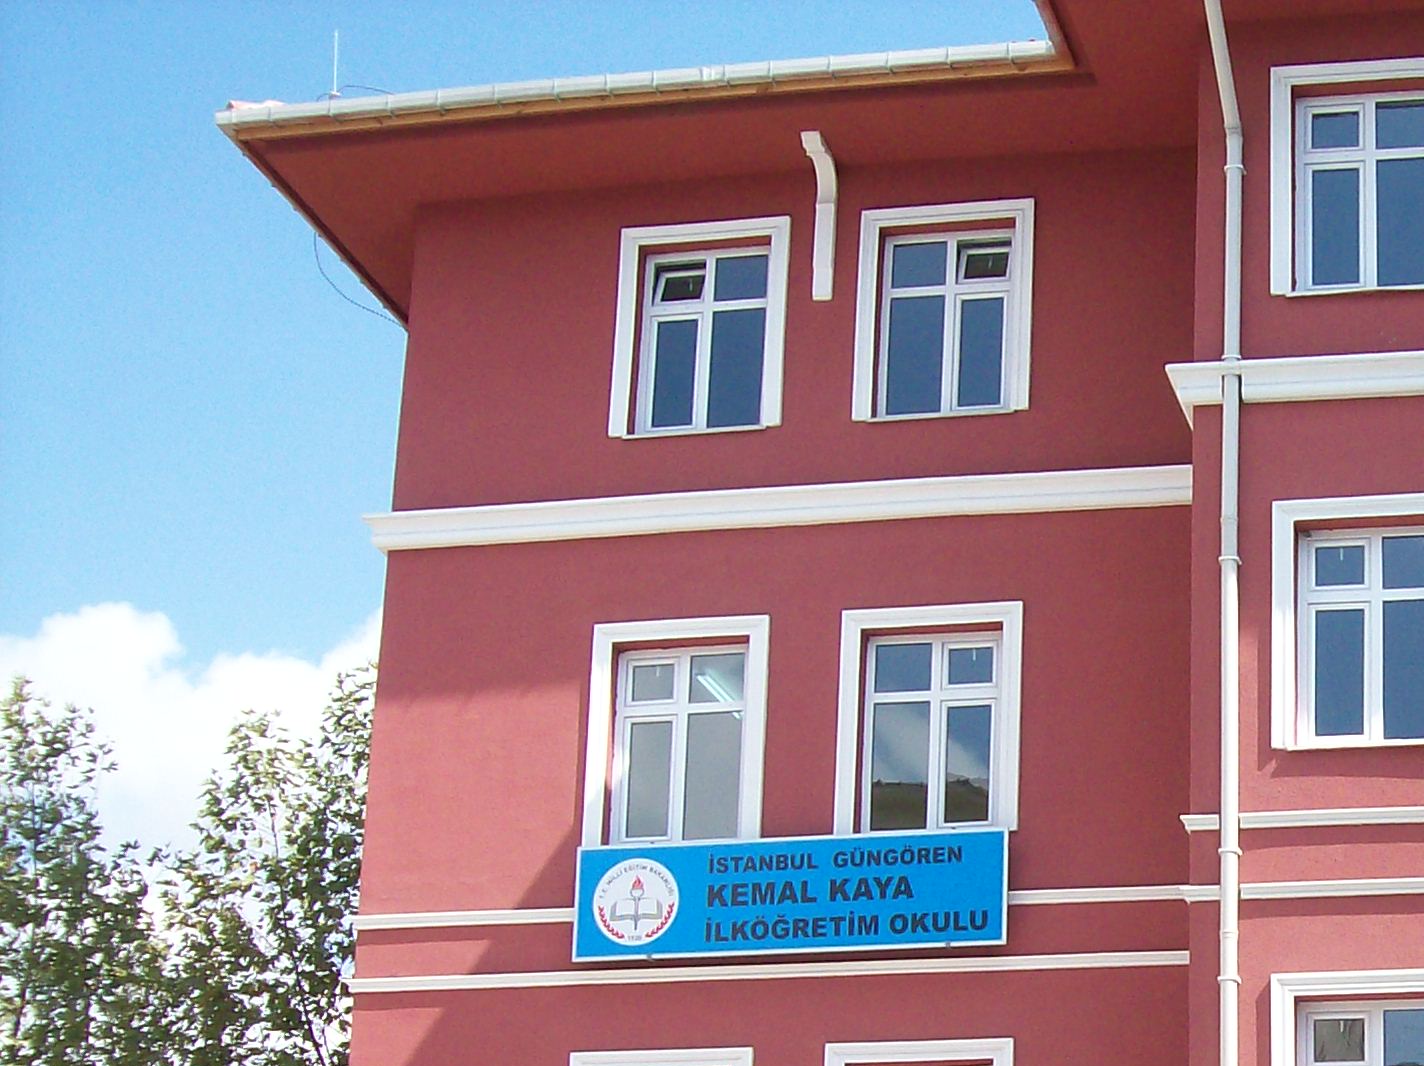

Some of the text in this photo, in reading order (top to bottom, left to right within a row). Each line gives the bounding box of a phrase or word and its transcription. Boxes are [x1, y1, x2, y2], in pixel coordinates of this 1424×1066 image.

[709, 844, 963, 874] İSTANBUL GÜNGÖREN
[707, 875, 914, 908] KEMAL KAYA
[705, 909, 989, 943] İLKÖĞRETİM OKULU
